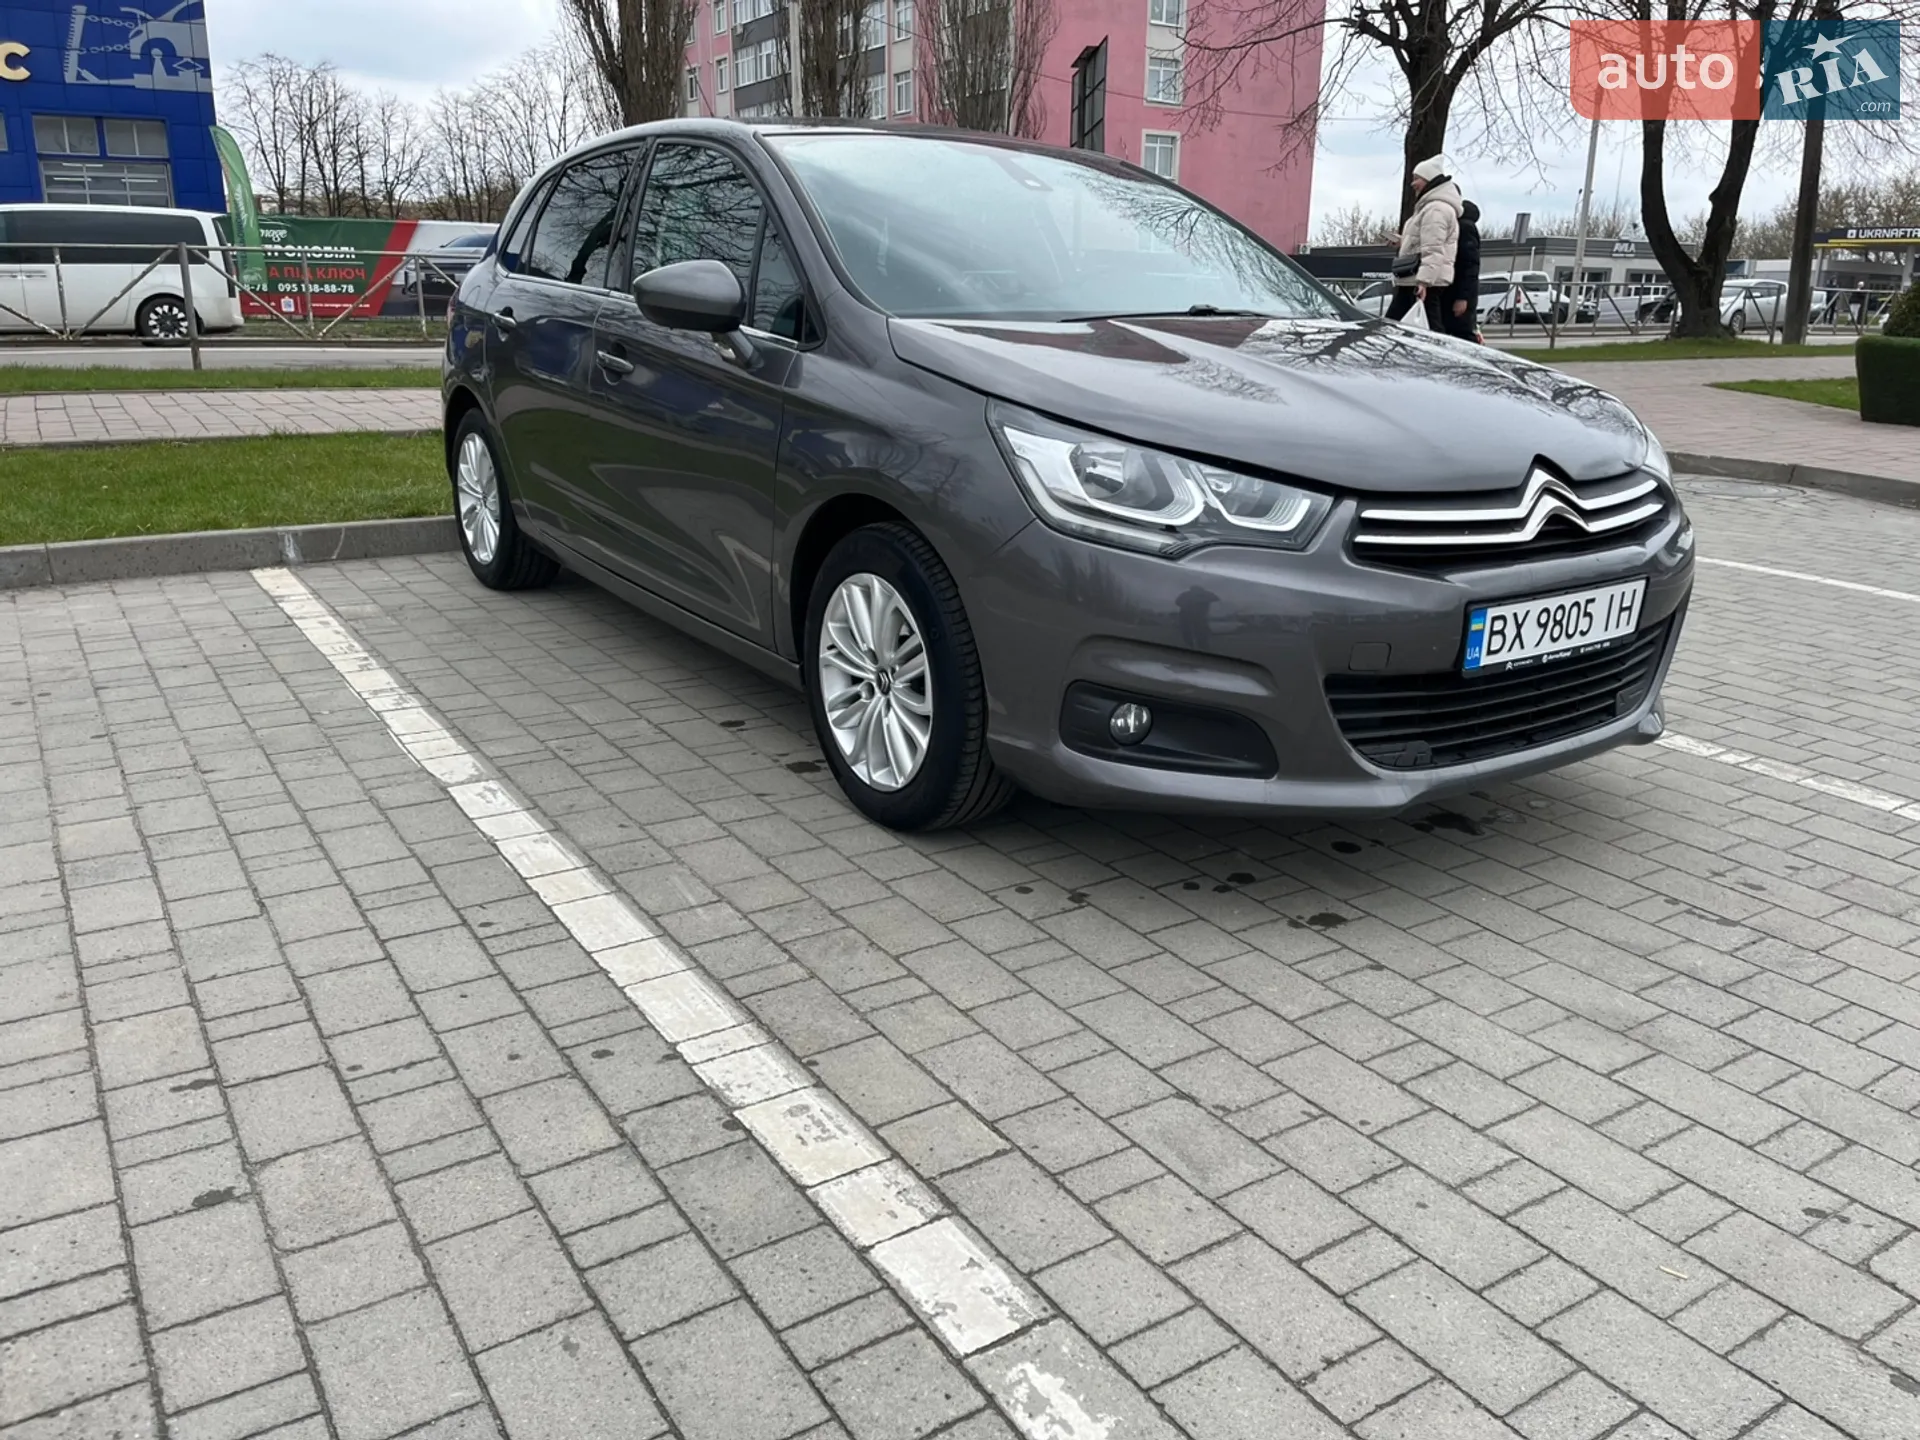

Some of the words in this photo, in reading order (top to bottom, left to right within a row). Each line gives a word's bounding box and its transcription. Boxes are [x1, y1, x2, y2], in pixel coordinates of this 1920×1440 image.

[1859, 228, 1920, 239] UKRNAFTA
[316, 267, 366, 280] КЛЮЧ
[1486, 609, 1531, 656] BX
[1534, 598, 1597, 648] 9805
[1466, 646, 1480, 661] UA
